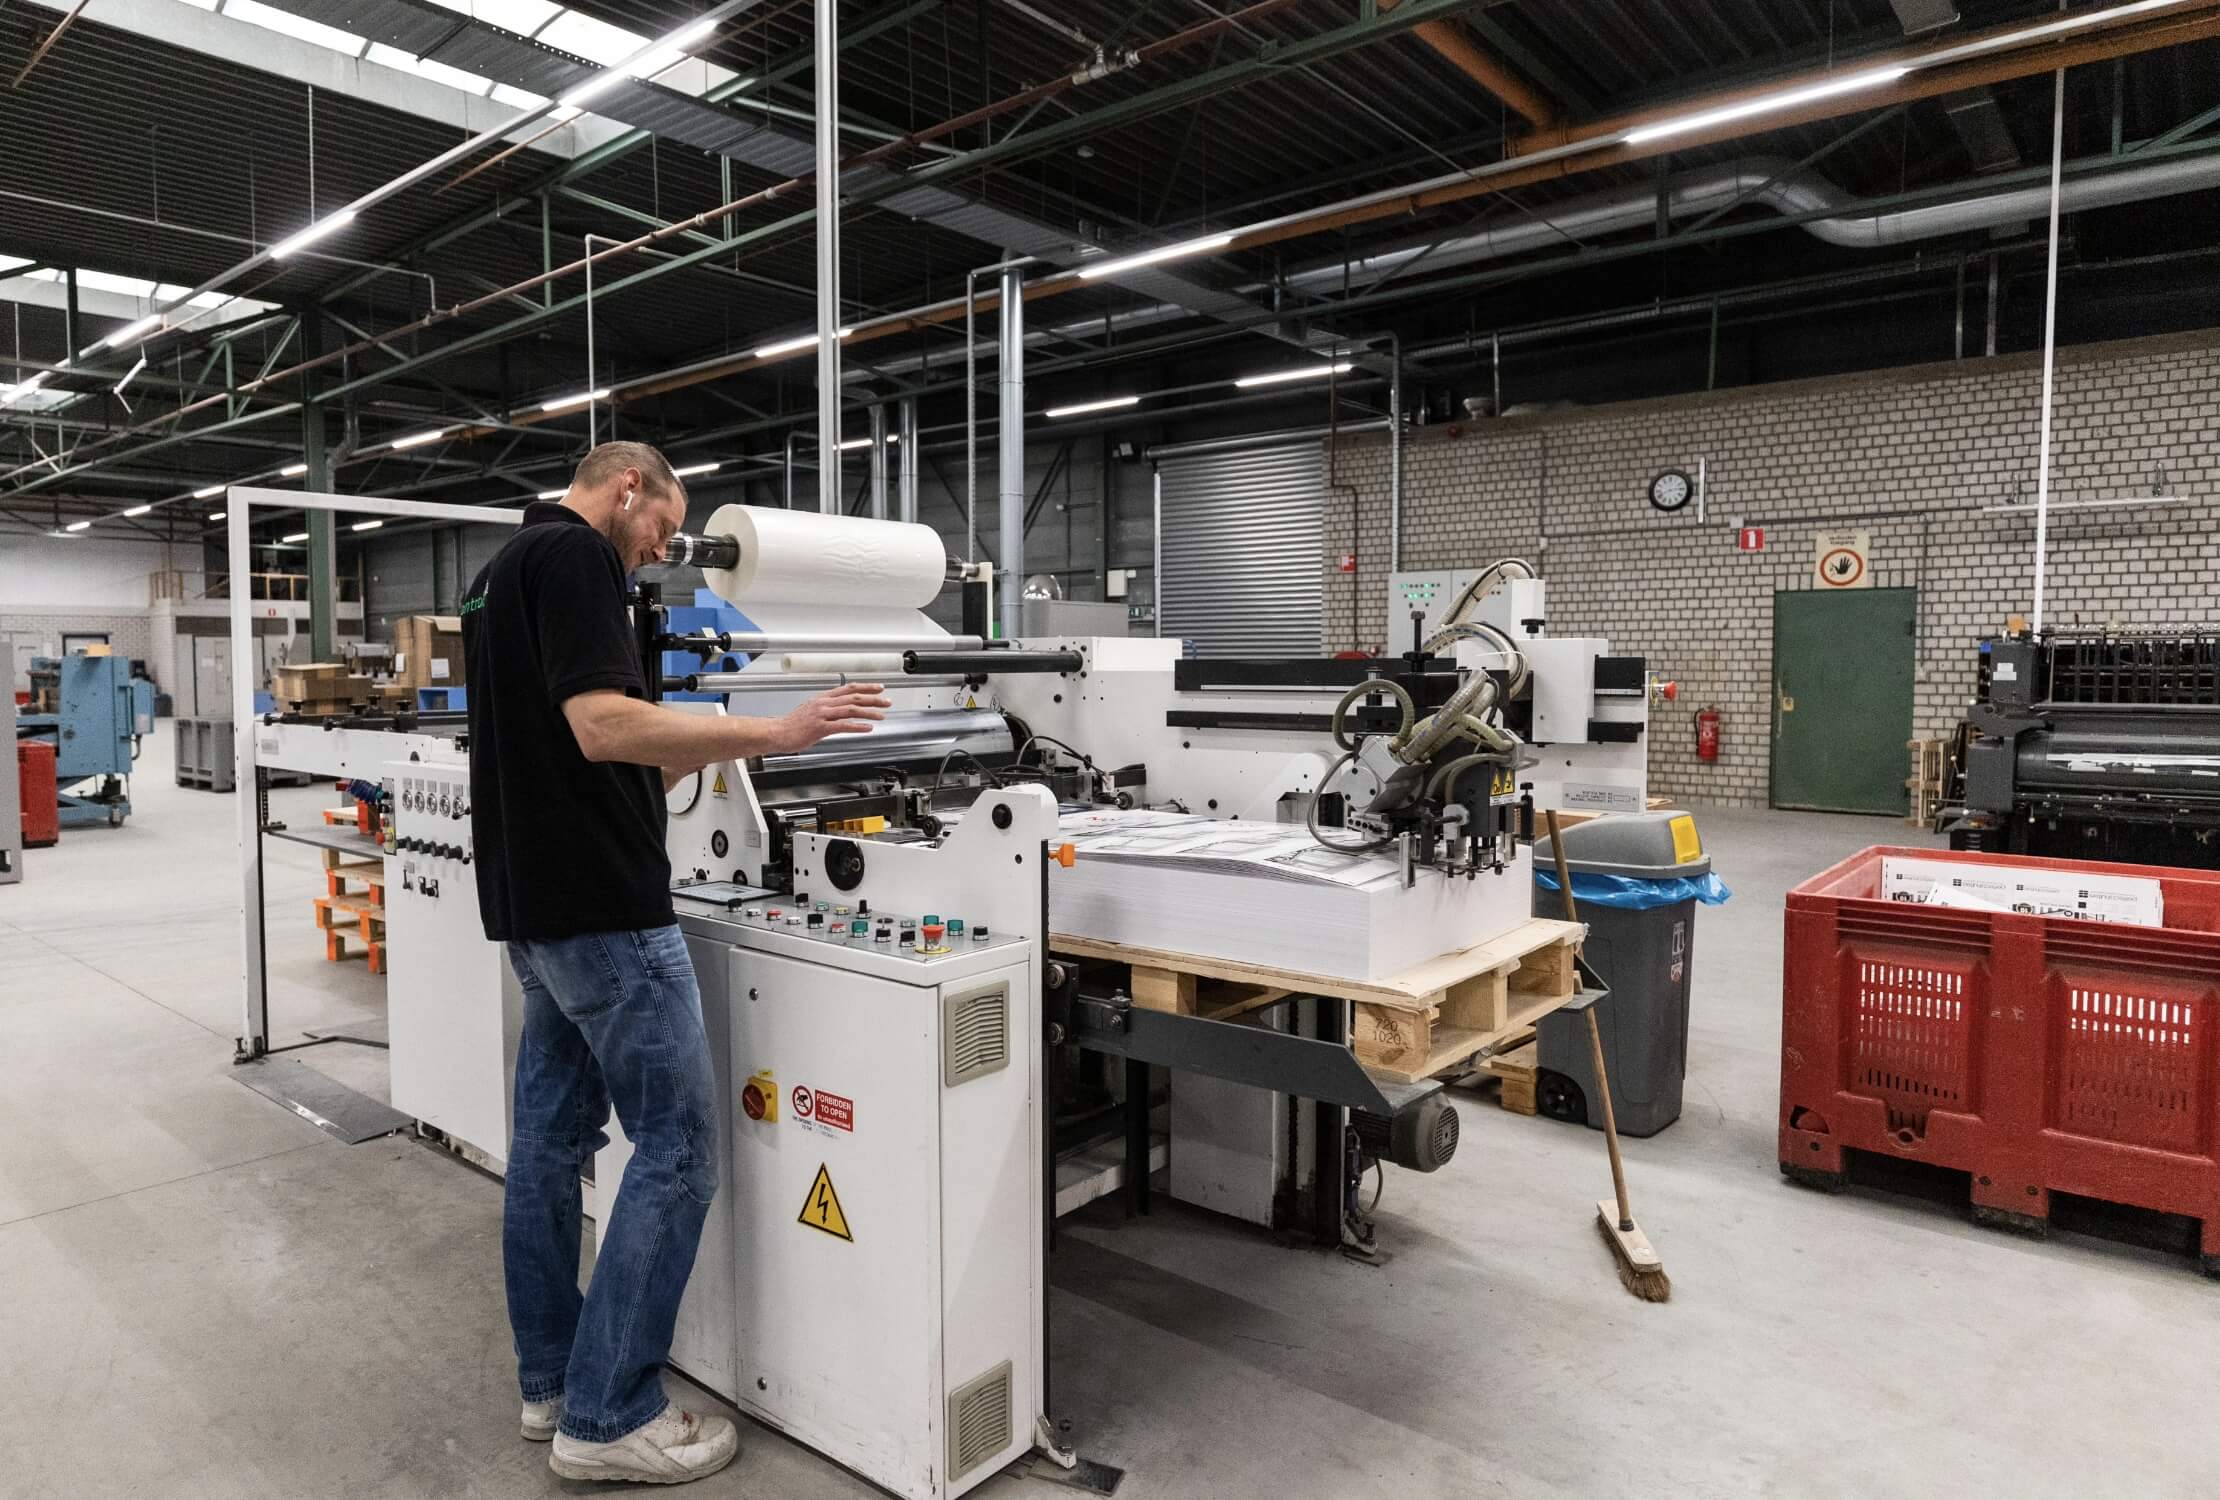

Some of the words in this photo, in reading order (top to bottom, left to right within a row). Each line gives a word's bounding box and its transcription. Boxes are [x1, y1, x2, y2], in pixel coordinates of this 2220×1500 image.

[1376, 1017, 1398, 1032] 720
[1374, 1030, 1401, 1045] 1020
[816, 1092, 852, 1112] FORBIDDEN
[820, 1104, 829, 1114] TO
[830, 1107, 848, 1120] OPEN
